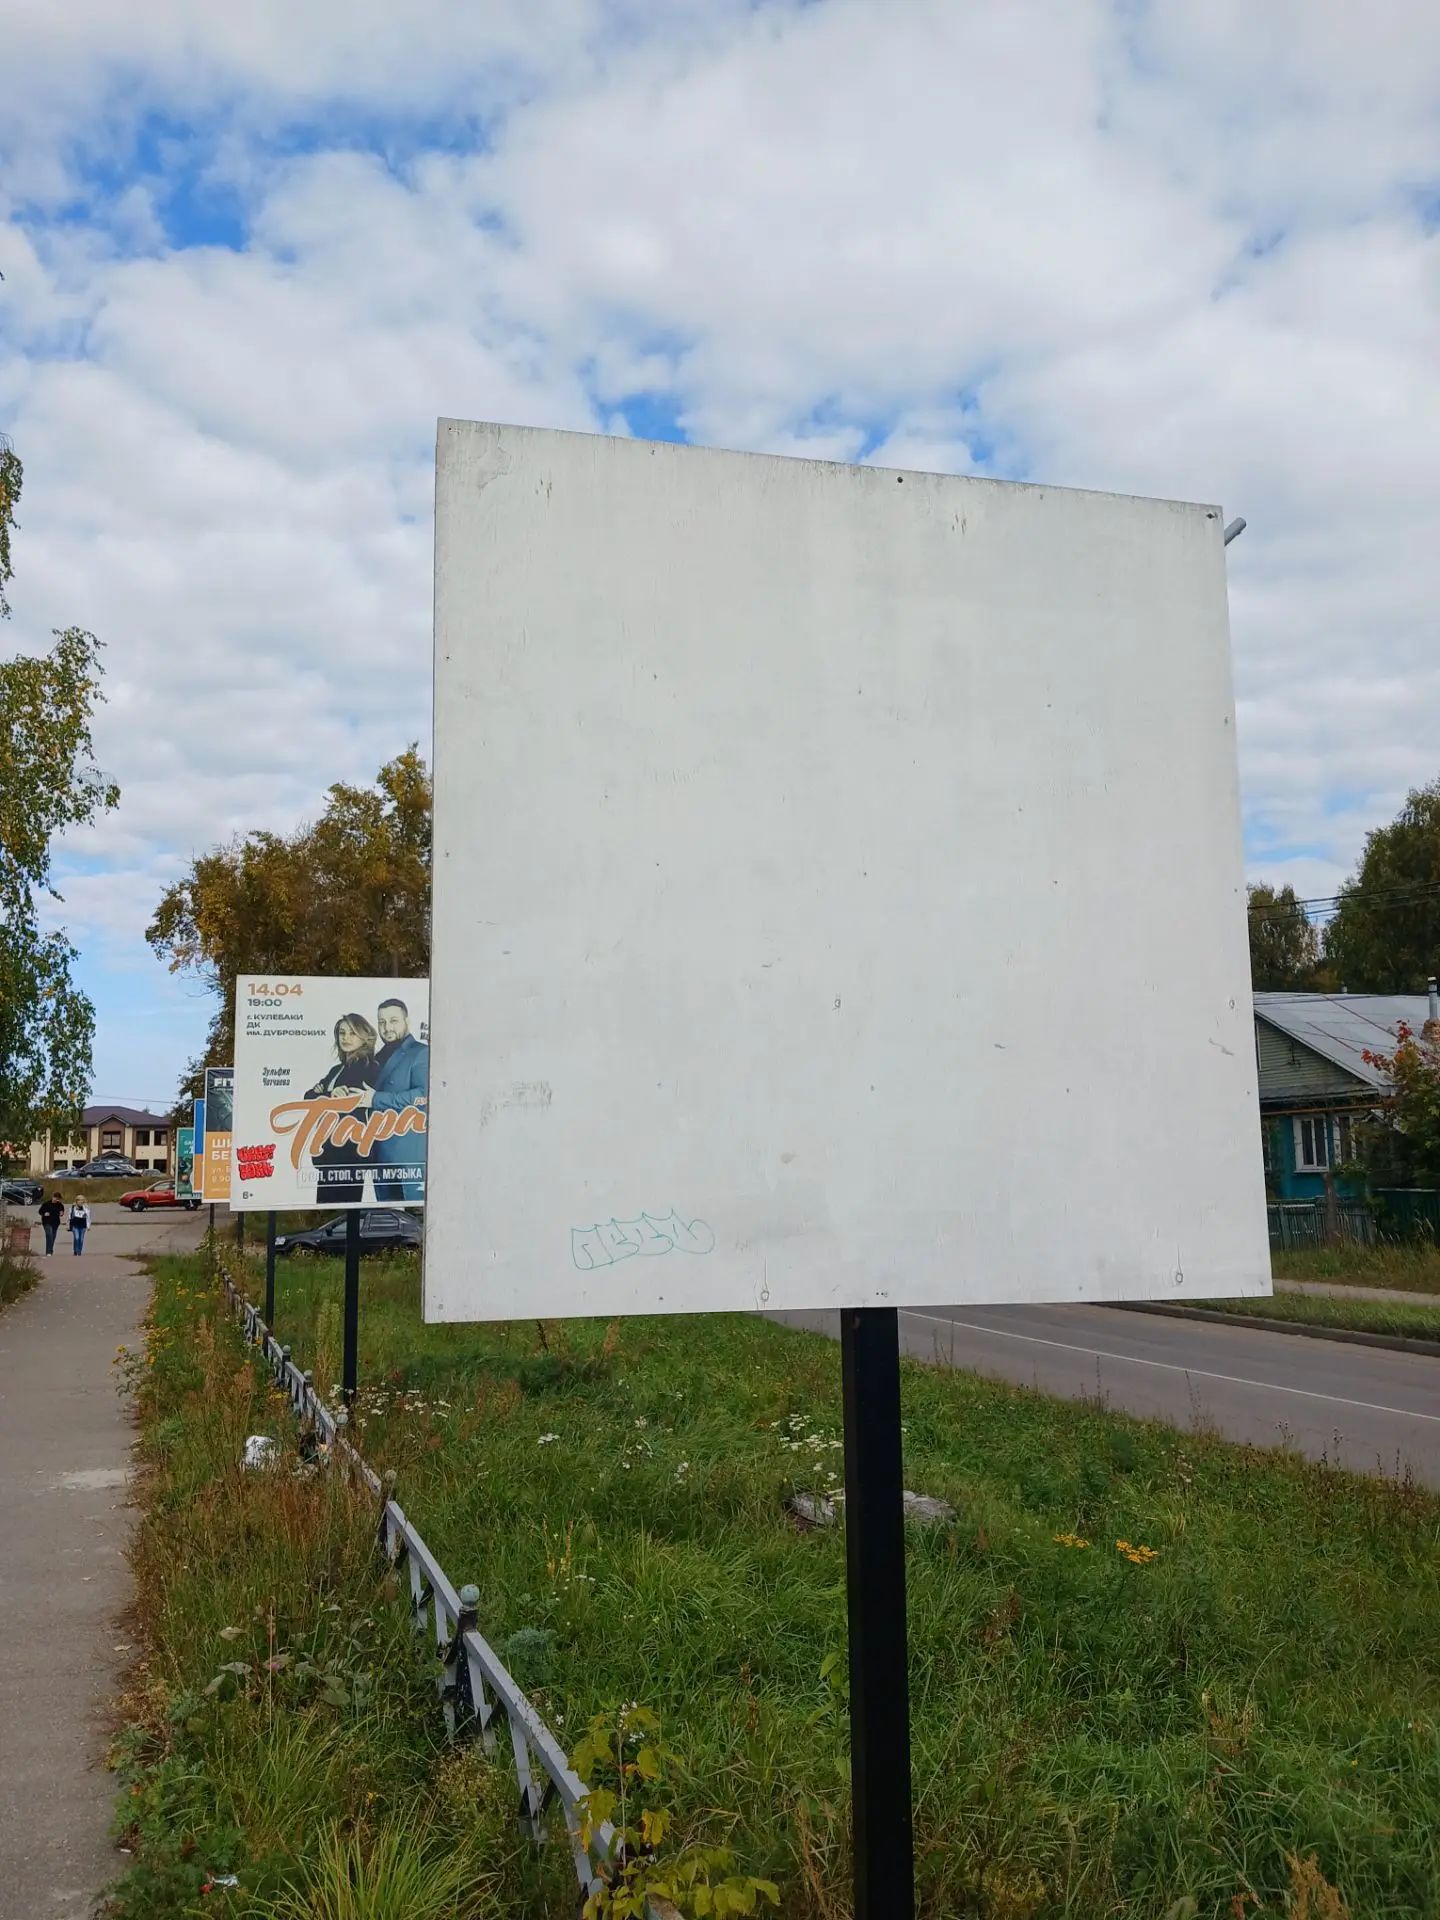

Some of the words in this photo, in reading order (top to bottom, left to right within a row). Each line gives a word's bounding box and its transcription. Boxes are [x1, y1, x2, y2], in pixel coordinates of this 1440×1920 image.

[248, 983, 303, 996] 14.04
[247, 998, 282, 1007] 19:00
[246, 1021, 261, 1029] ДК
[262, 1066, 291, 1077] Зульфия
[269, 1095, 427, 1170] Пара
[327, 1169, 354, 1182] СТОП,
[382, 1167, 423, 1180] МУЗЫКА
